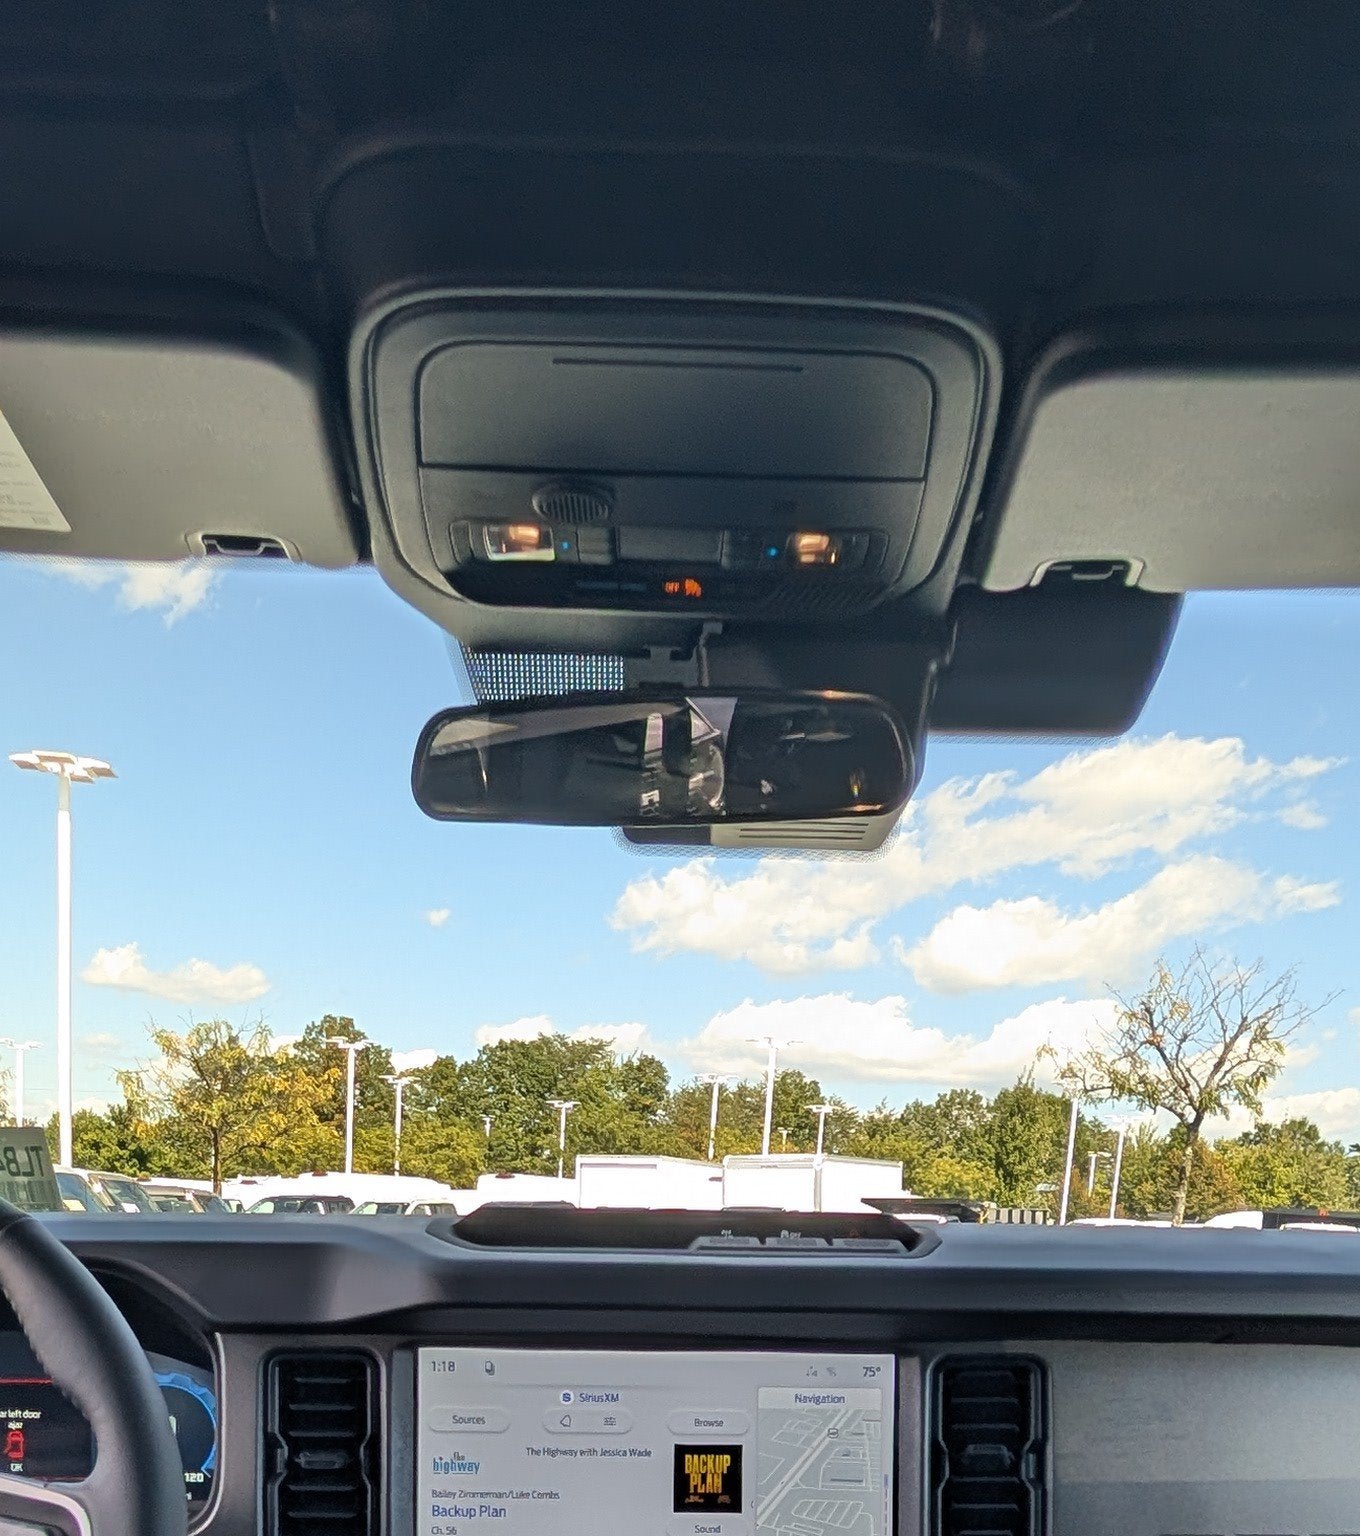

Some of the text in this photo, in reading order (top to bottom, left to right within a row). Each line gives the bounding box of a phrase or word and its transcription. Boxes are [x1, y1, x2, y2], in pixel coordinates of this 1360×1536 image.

[431, 1360, 456, 1373] 1:18
[862, 1366, 881, 1377] 75°
[794, 1394, 846, 1405] Navigation
[8, 1409, 21, 1418] left
[22, 1409, 41, 1418] door
[452, 1414, 486, 1425] Sources
[694, 1418, 724, 1428] Browse
[526, 1447, 653, 1459] The Highway with Jessica Wade
[432, 1456, 480, 1475] highway
[685, 1454, 731, 1474] BACKUP
[689, 1473, 722, 1493] PLAN
[431, 1489, 456, 1500] Bailey
[532, 1490, 560, 1499] Combs
[431, 1505, 507, 1519] Backup Plan
[694, 1524, 721, 1534] Sound
